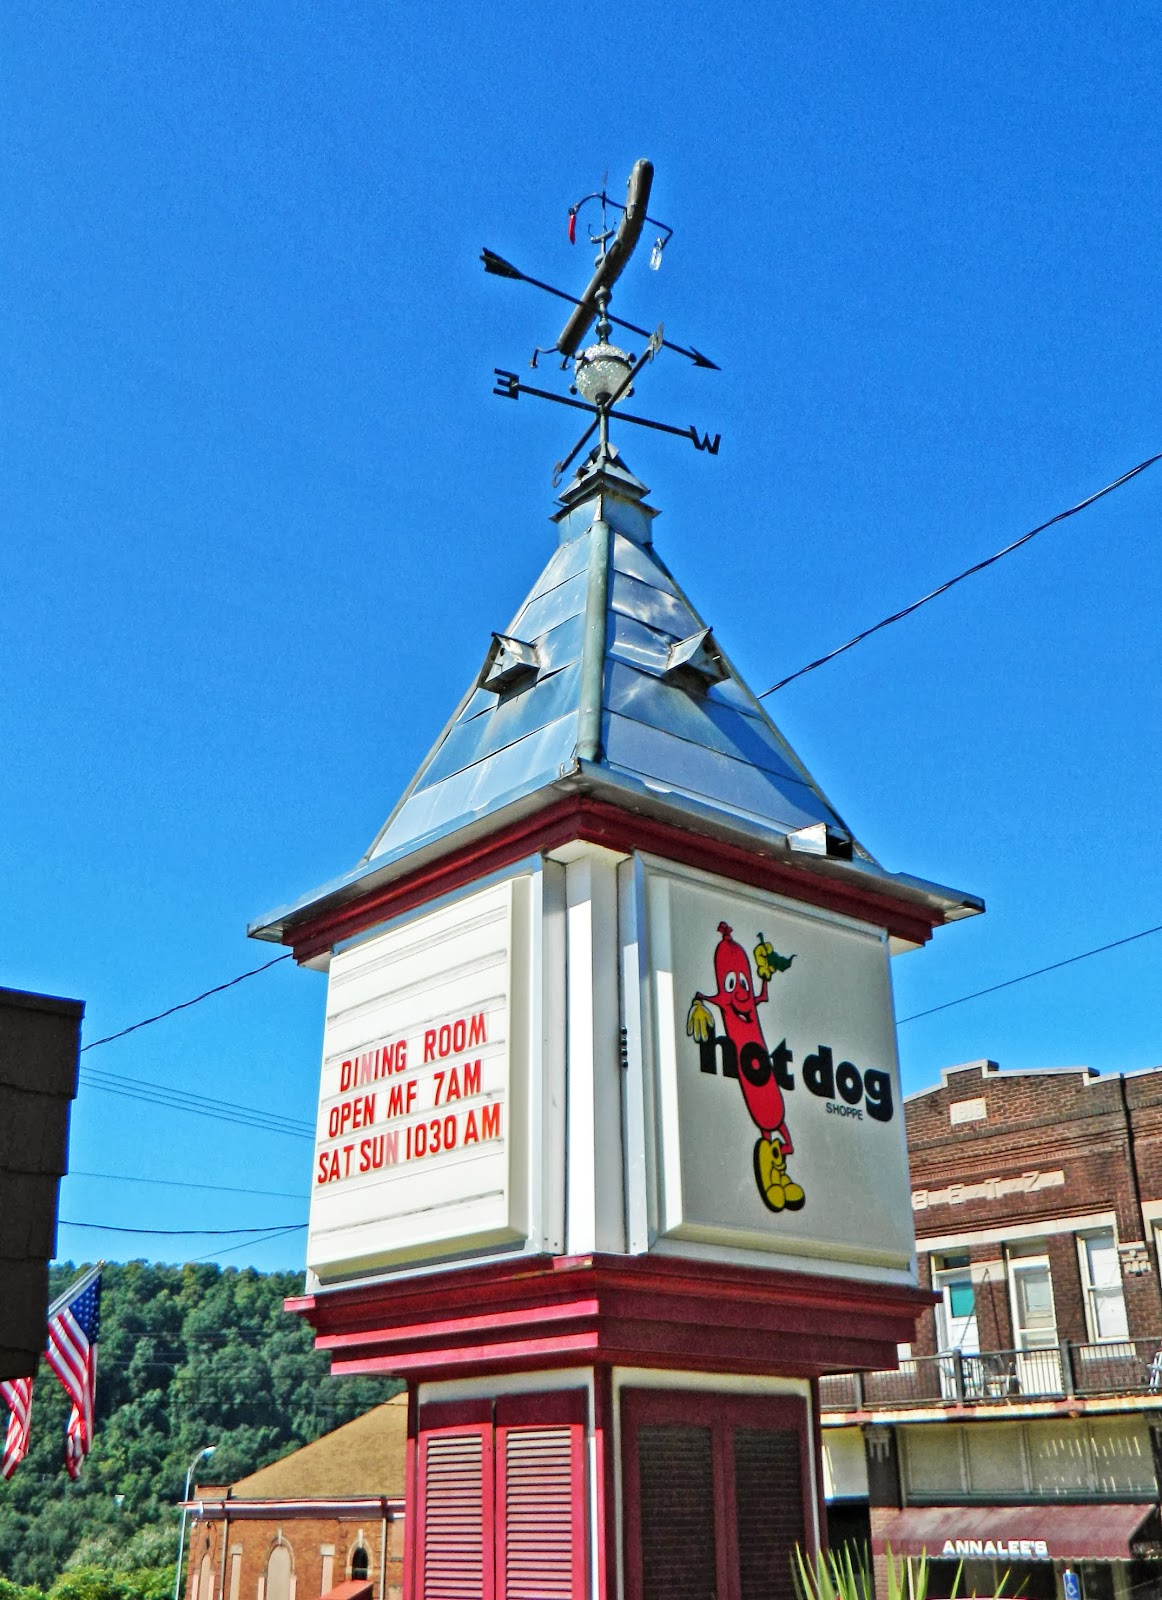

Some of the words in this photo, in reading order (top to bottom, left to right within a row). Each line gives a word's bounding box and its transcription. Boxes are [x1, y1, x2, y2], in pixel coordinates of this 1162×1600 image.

[689, 424, 722, 456] W
[339, 1039, 408, 1093] DINING
[423, 1011, 487, 1063] ROOM
[700, 1026, 795, 1091] hot
[802, 1044, 894, 1122] dog
[328, 1093, 376, 1138] OPEN
[387, 1079, 417, 1119] MF
[433, 1058, 482, 1106] 7AM
[825, 1101, 864, 1121] SHOPPE
[317, 1144, 355, 1184] SAT
[359, 1130, 399, 1173] SUN
[406, 1114, 458, 1160] 1030
[463, 1102, 501, 1145] AM
[911, 1170, 1041, 1211] BETZ
[942, 1539, 1048, 1557] ANNALEE'S
